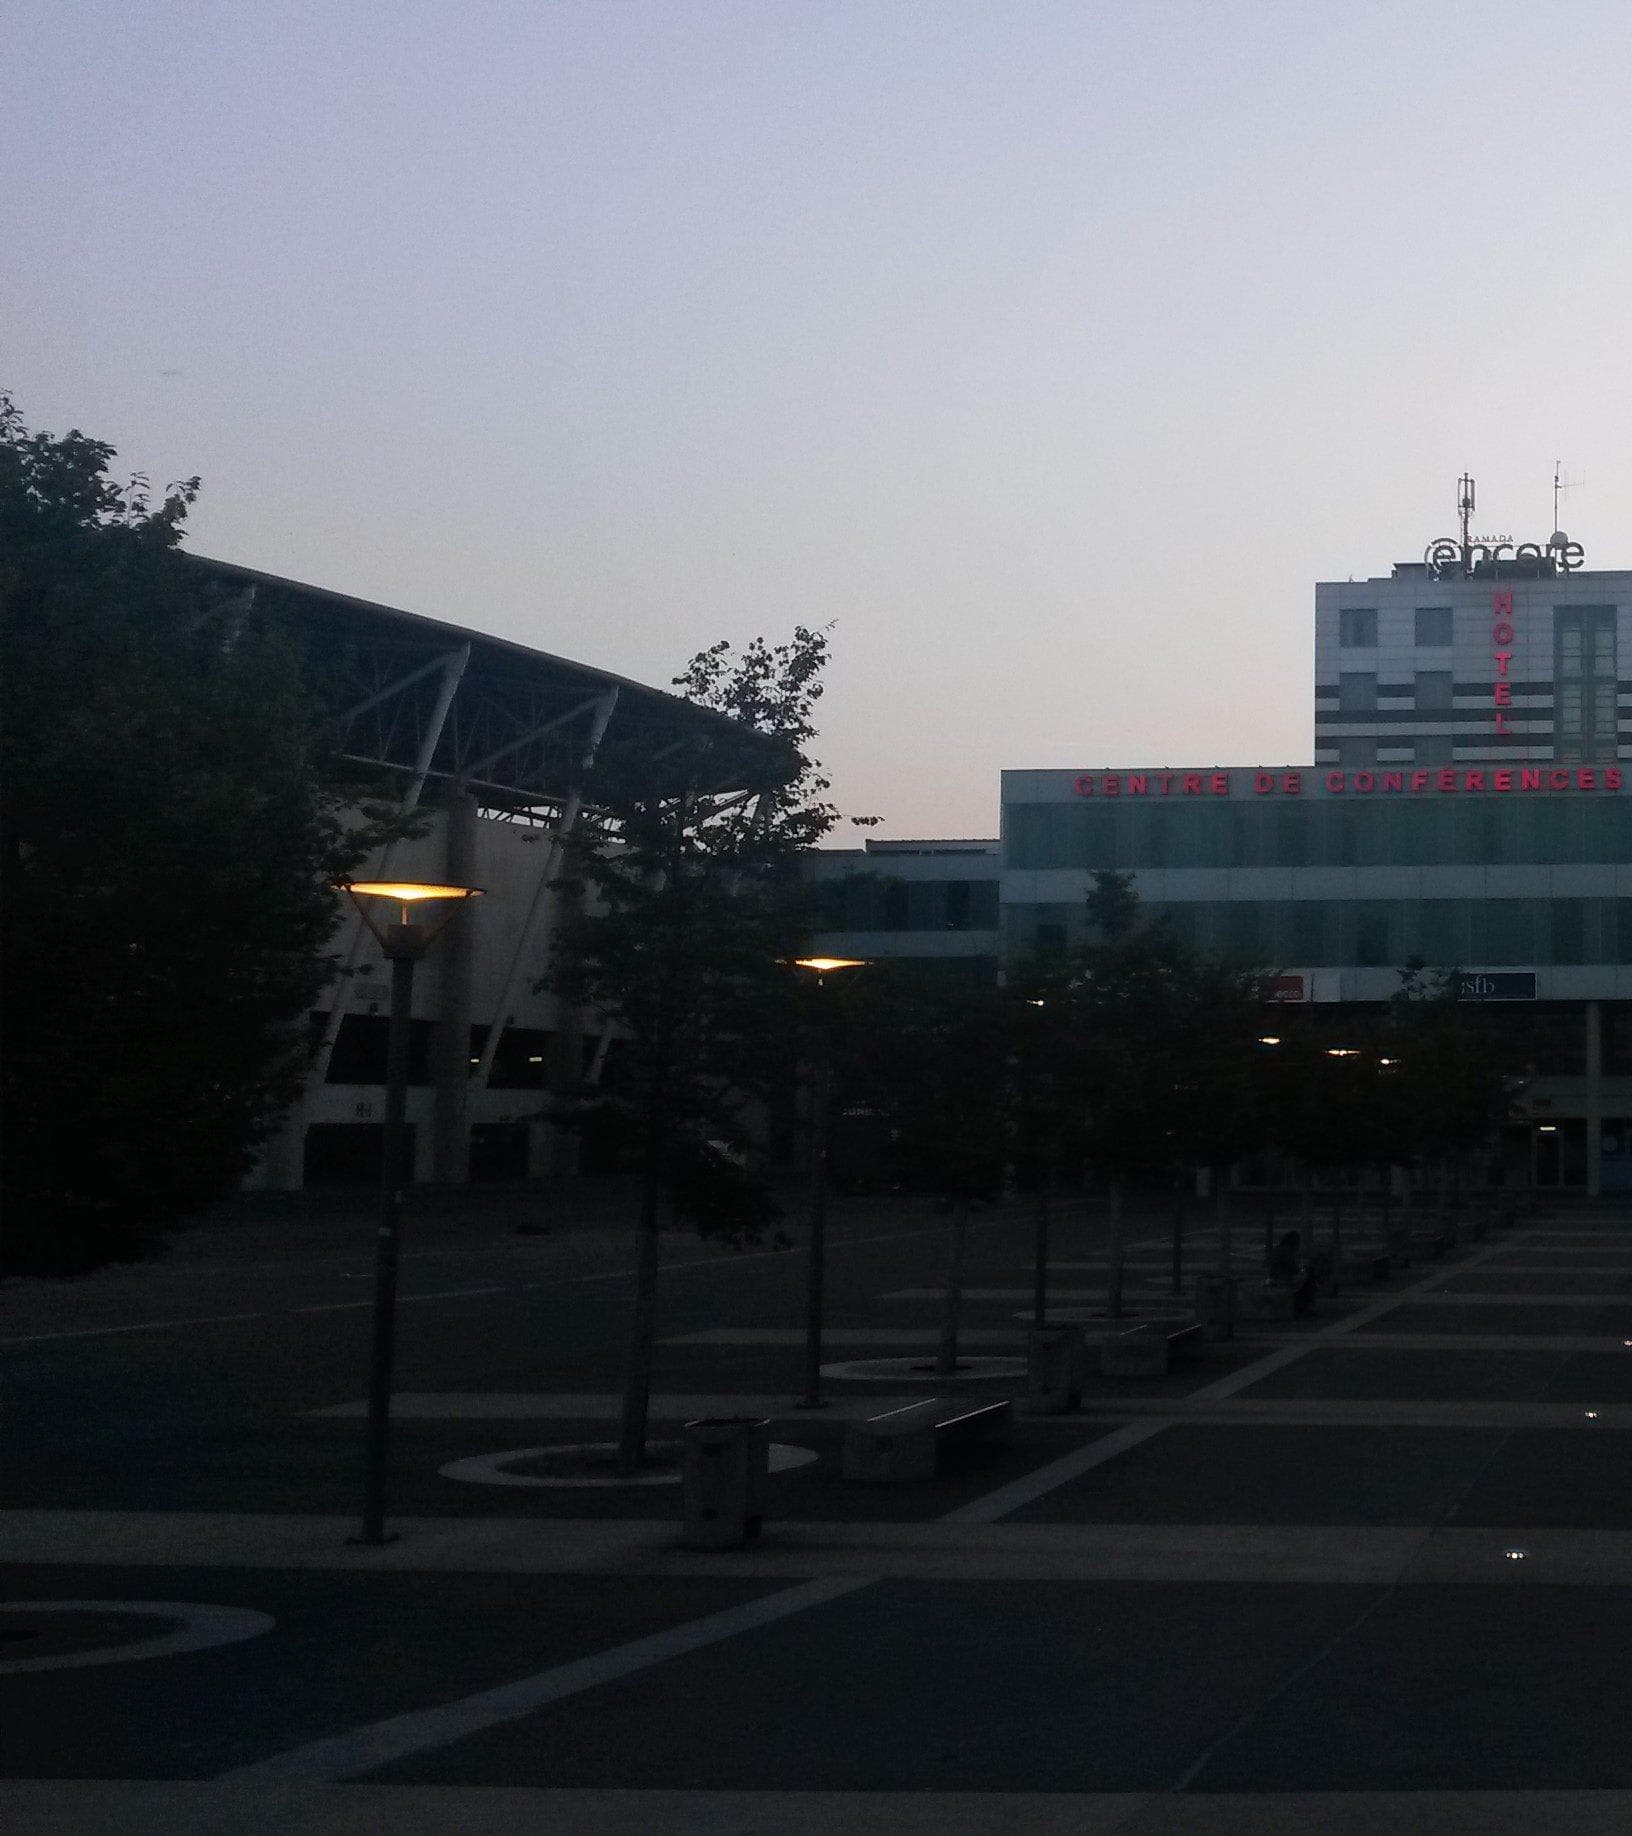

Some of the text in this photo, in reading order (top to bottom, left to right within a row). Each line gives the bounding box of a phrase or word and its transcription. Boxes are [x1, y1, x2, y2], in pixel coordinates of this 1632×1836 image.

[1493, 591, 1515, 735] HOTEL
[1074, 773, 1230, 796] CENTRE
[1254, 774, 1302, 794] DE
